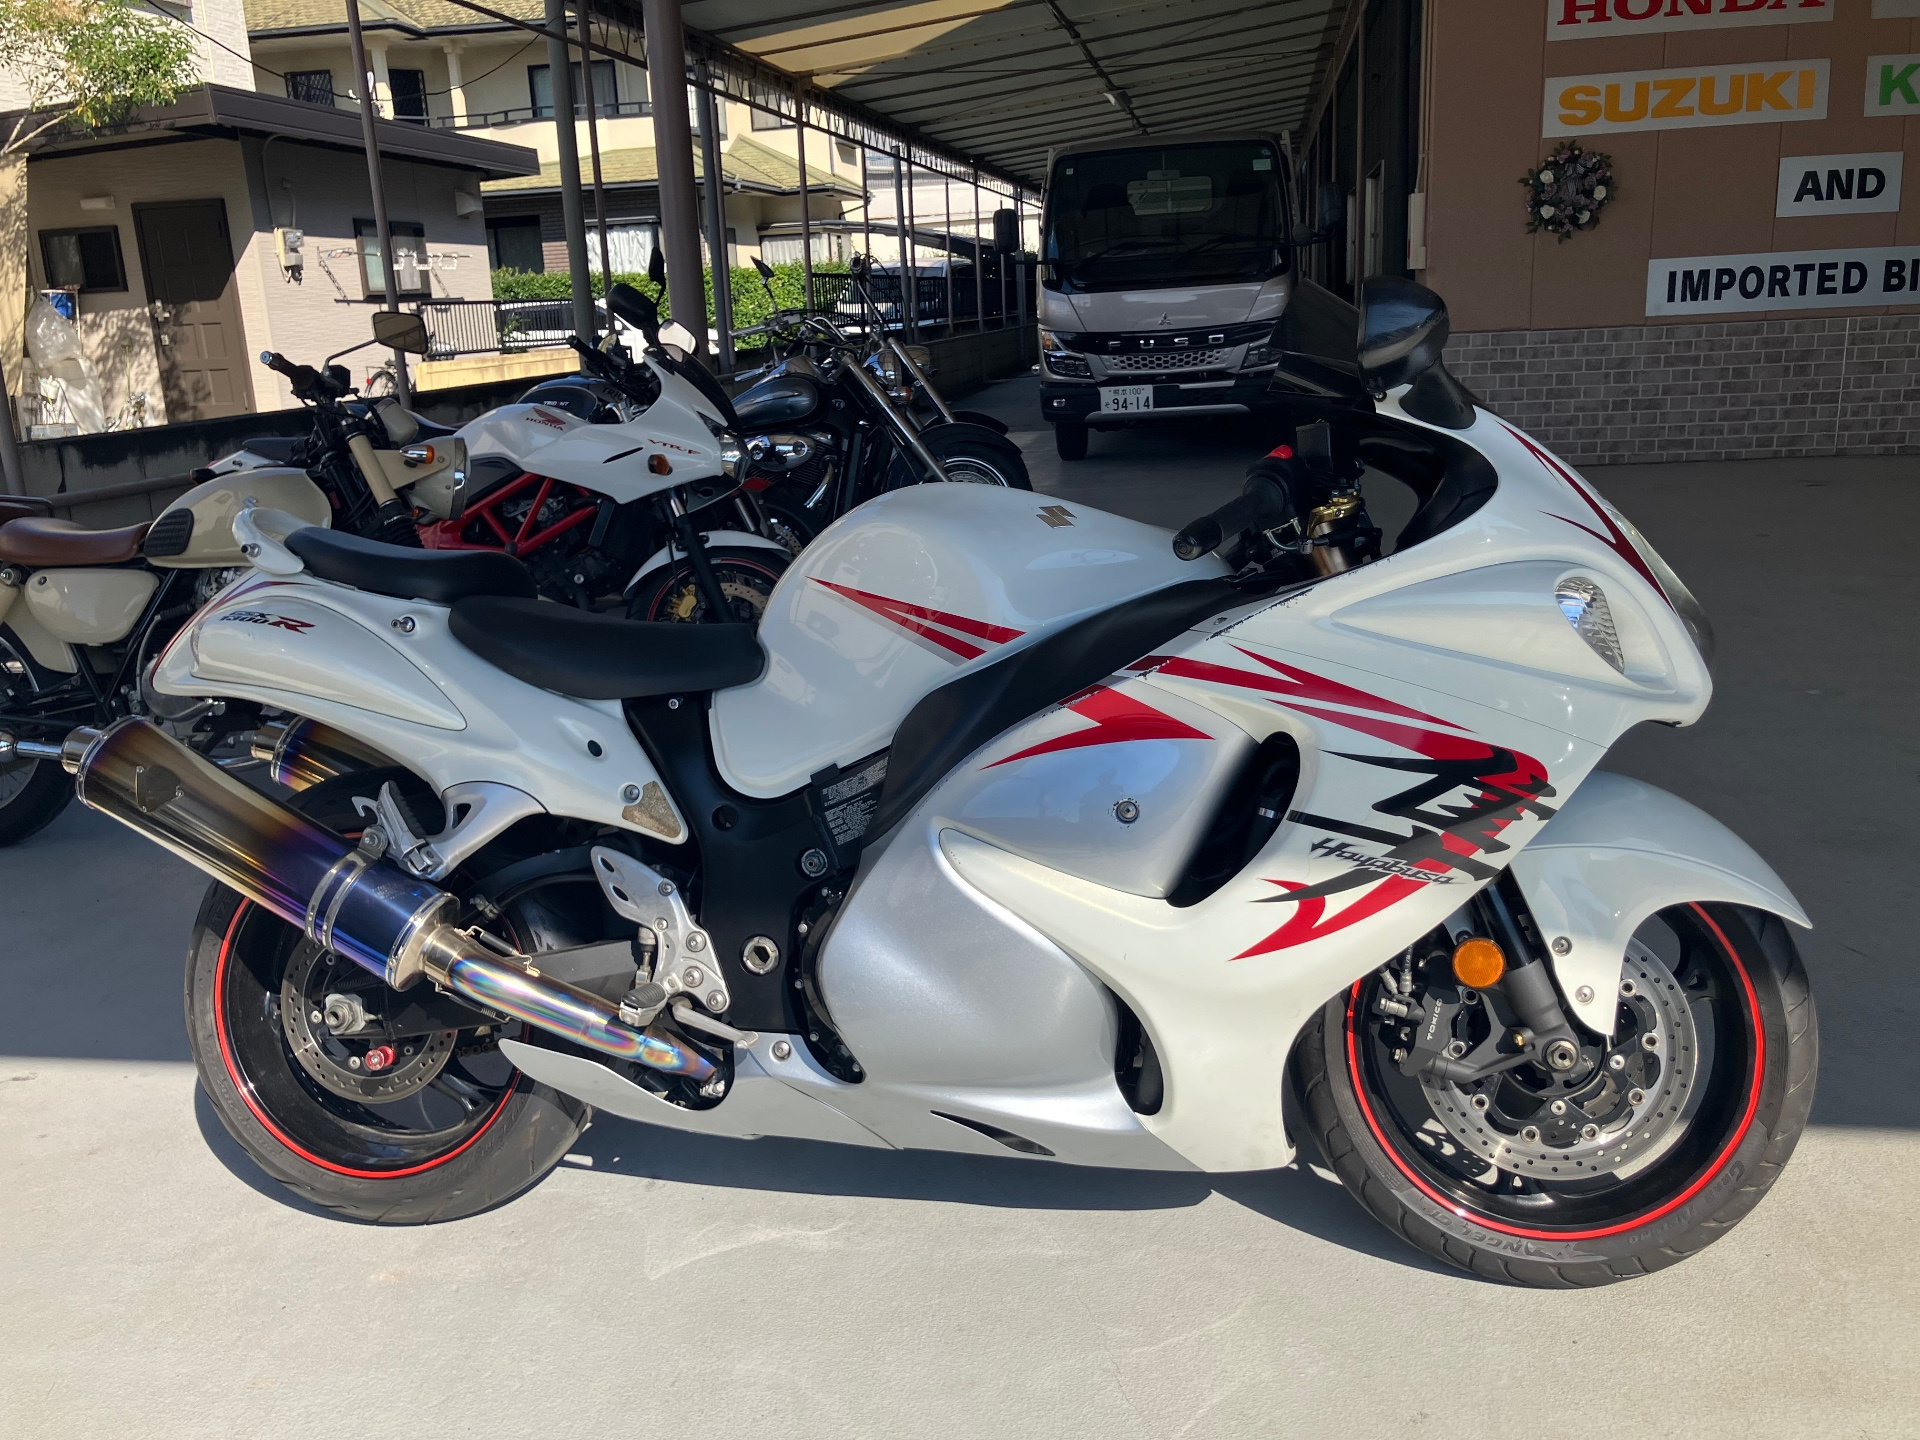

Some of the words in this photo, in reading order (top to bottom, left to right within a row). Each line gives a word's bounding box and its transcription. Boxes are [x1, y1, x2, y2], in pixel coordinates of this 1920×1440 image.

[1557, 0, 1826, 25] HON
[1558, 69, 1816, 126] SUZUKI
[1793, 167, 1886, 203] AND
[1666, 261, 1868, 303] IMPORTED
[1108, 334, 1224, 350] FUSO
[1112, 396, 1150, 411] 94-14
[526, 417, 564, 431] HONDA
[1310, 837, 1458, 884] Hayabusa
[1426, 998, 1443, 1041] TOKICO
